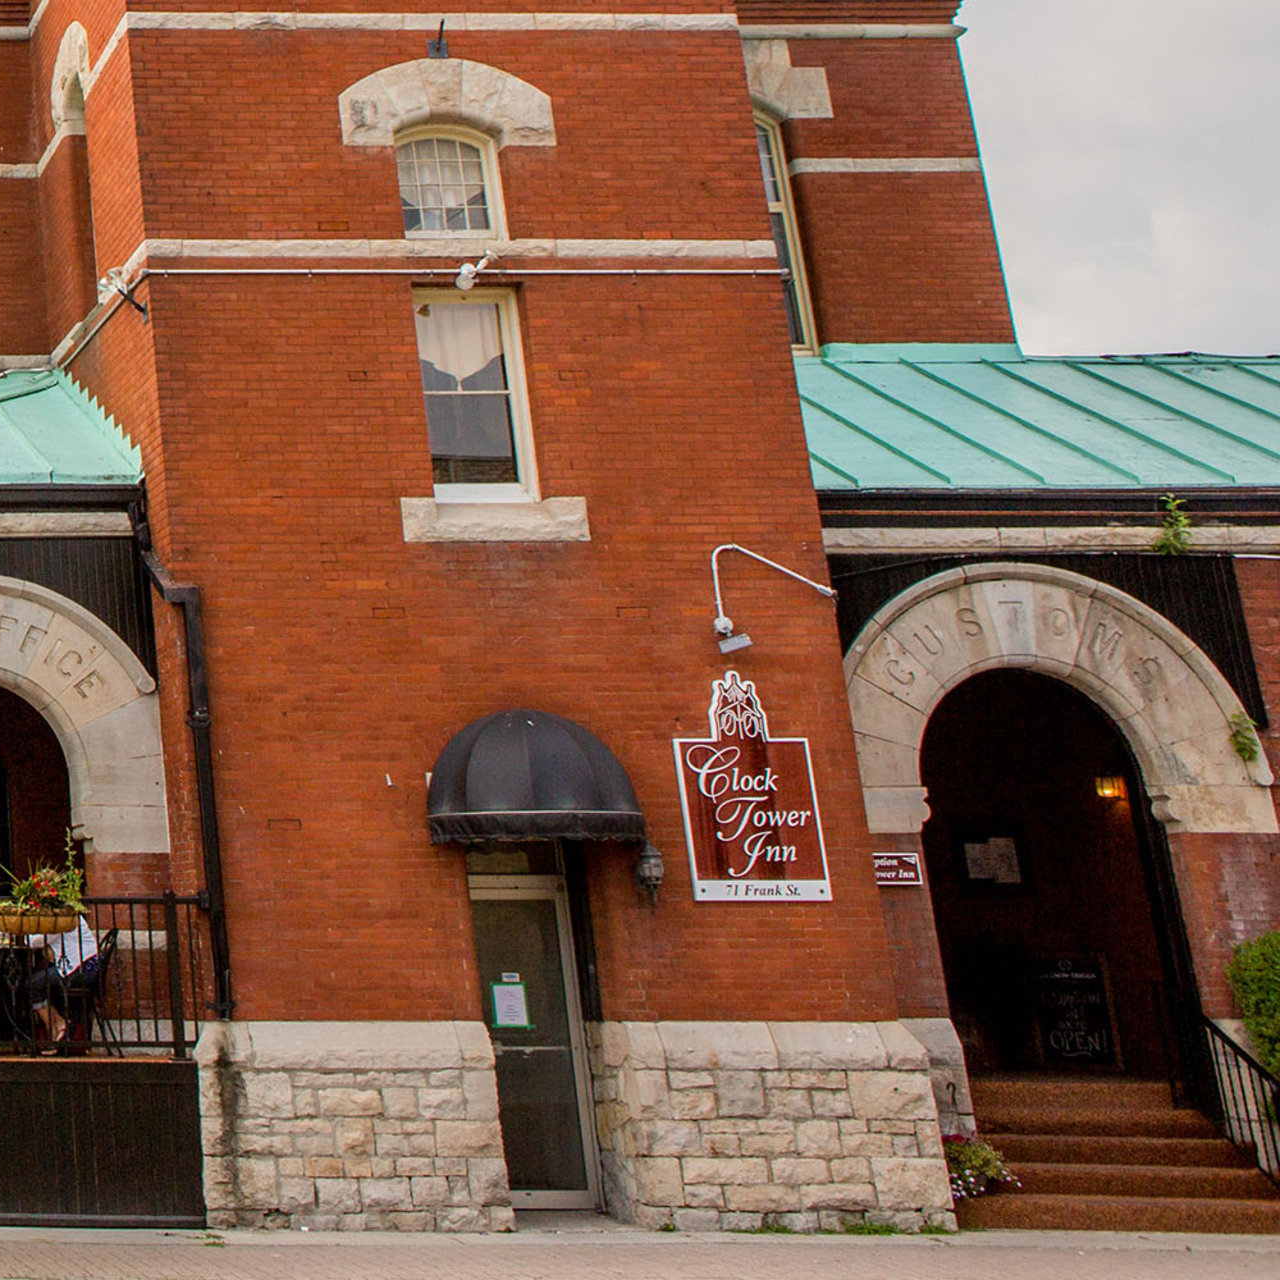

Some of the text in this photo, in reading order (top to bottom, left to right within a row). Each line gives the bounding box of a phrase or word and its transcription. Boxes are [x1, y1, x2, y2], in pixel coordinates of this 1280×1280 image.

[886, 601, 1163, 686] CUSTOMS
[686, 744, 779, 804] Clock
[715, 795, 811, 842] Tower
[727, 831, 798, 878] Inn
[873, 857, 898, 869] ption
[874, 869, 915, 879] ower Inn
[726, 884, 802, 897] 71 Frank St.
